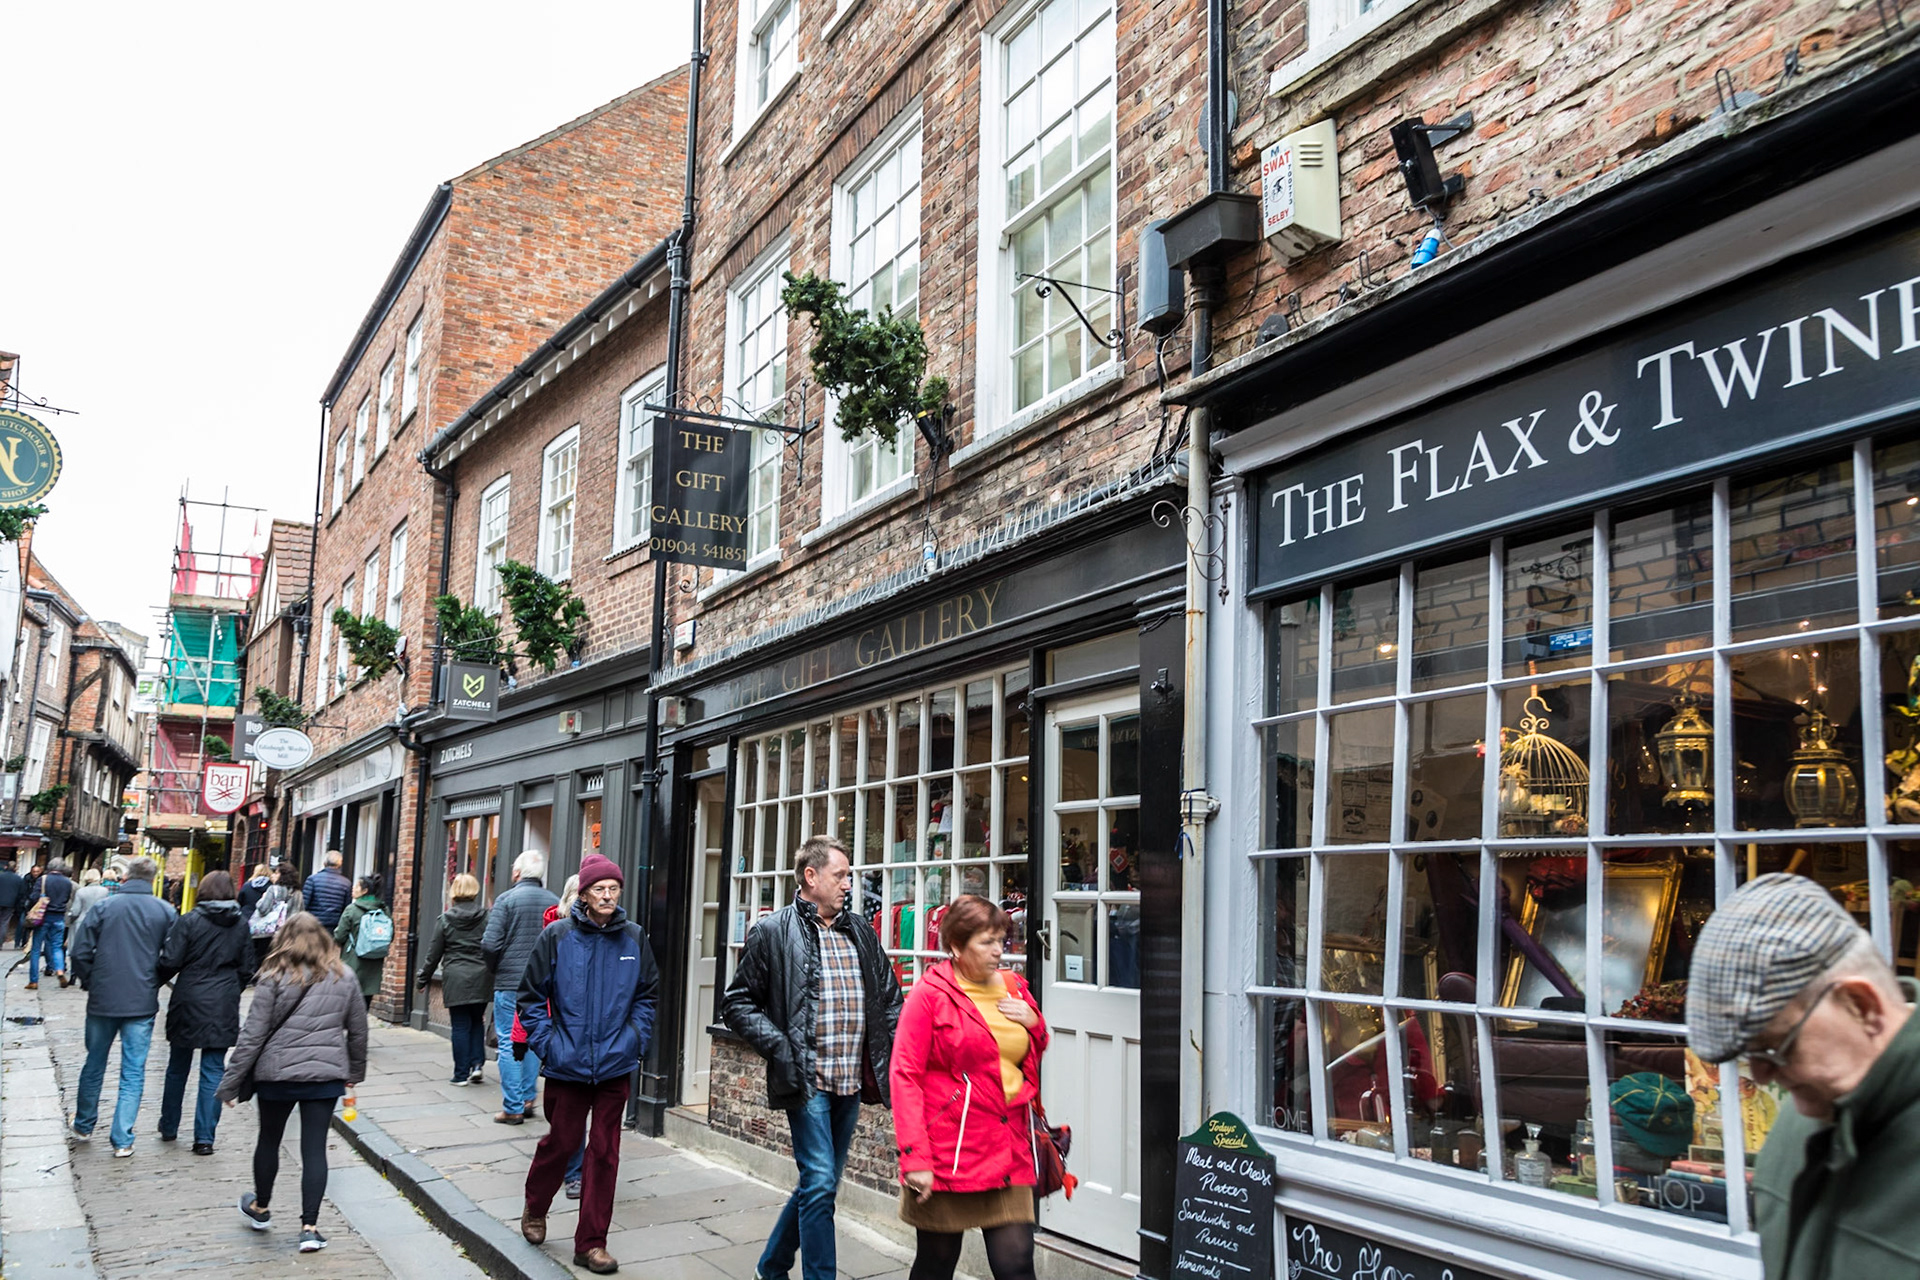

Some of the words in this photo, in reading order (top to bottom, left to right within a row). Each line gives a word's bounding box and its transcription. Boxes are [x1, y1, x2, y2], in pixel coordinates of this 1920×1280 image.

[1263, 150, 1291, 177] SWAT
[1268, 208, 1290, 227] SELBY
[1568, 390, 1621, 455] &
[0, 419, 47, 455] UTCRACKER
[679, 431, 725, 454] THE
[2, 487, 28, 498] SHOP
[676, 470, 726, 492] GIFT
[651, 505, 747, 534] GALLERY
[650, 537, 697, 556] 01904
[703, 544, 746, 562] 541851
[782, 645, 834, 692] GIFT
[855, 580, 1004, 667] GALLERY
[453, 699, 491, 709] ZATCHELS
[440, 743, 473, 764] ZATCHELS
[1209, 1119, 1237, 1136] Todays
[1265, 1104, 1308, 1133] HOME
[1213, 1133, 1248, 1149] Special
[1185, 1147, 1213, 1170] Meat
[1217, 1157, 1238, 1174] and
[1236, 1224, 1256, 1237] and
[1293, 1223, 1342, 1273] The
